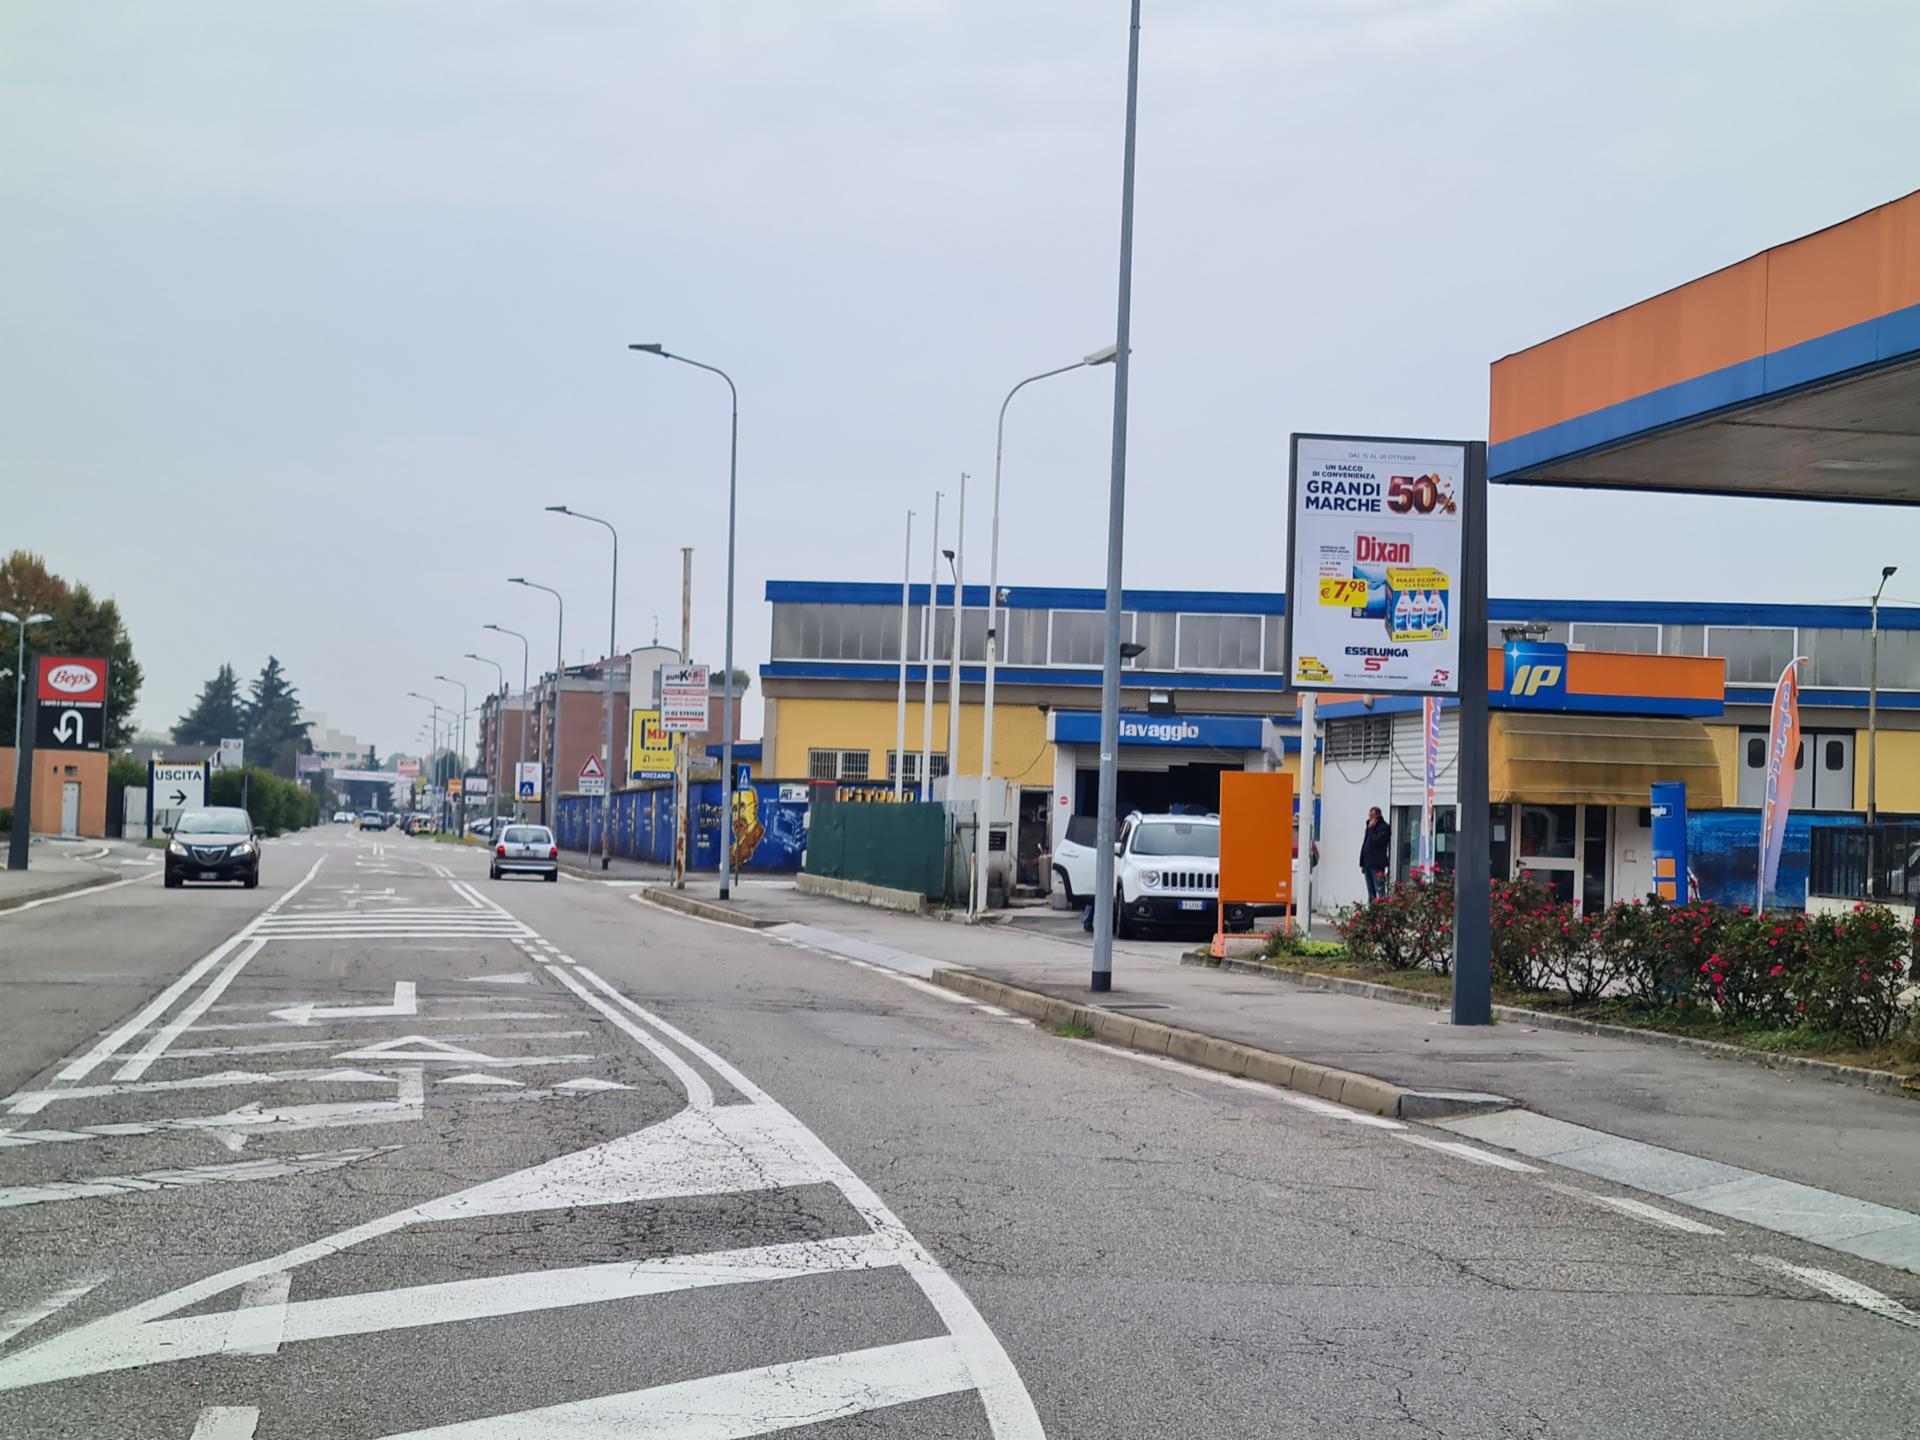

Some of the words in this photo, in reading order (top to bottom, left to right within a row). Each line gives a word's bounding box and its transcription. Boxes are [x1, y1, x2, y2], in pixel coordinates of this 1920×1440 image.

[1321, 471, 1375, 480] CONVENIENZA
[1306, 480, 1380, 496] GRANDI
[1305, 496, 1381, 512] MARCHE
[1356, 535, 1411, 564] Dixan
[1320, 587, 1330, 599] €
[1344, 646, 1409, 658] ESSELUNGA
[1510, 664, 1562, 697] IP
[646, 728, 667, 740] MD
[1119, 719, 1199, 742] lavaggio
[155, 769, 202, 781] USCITA
